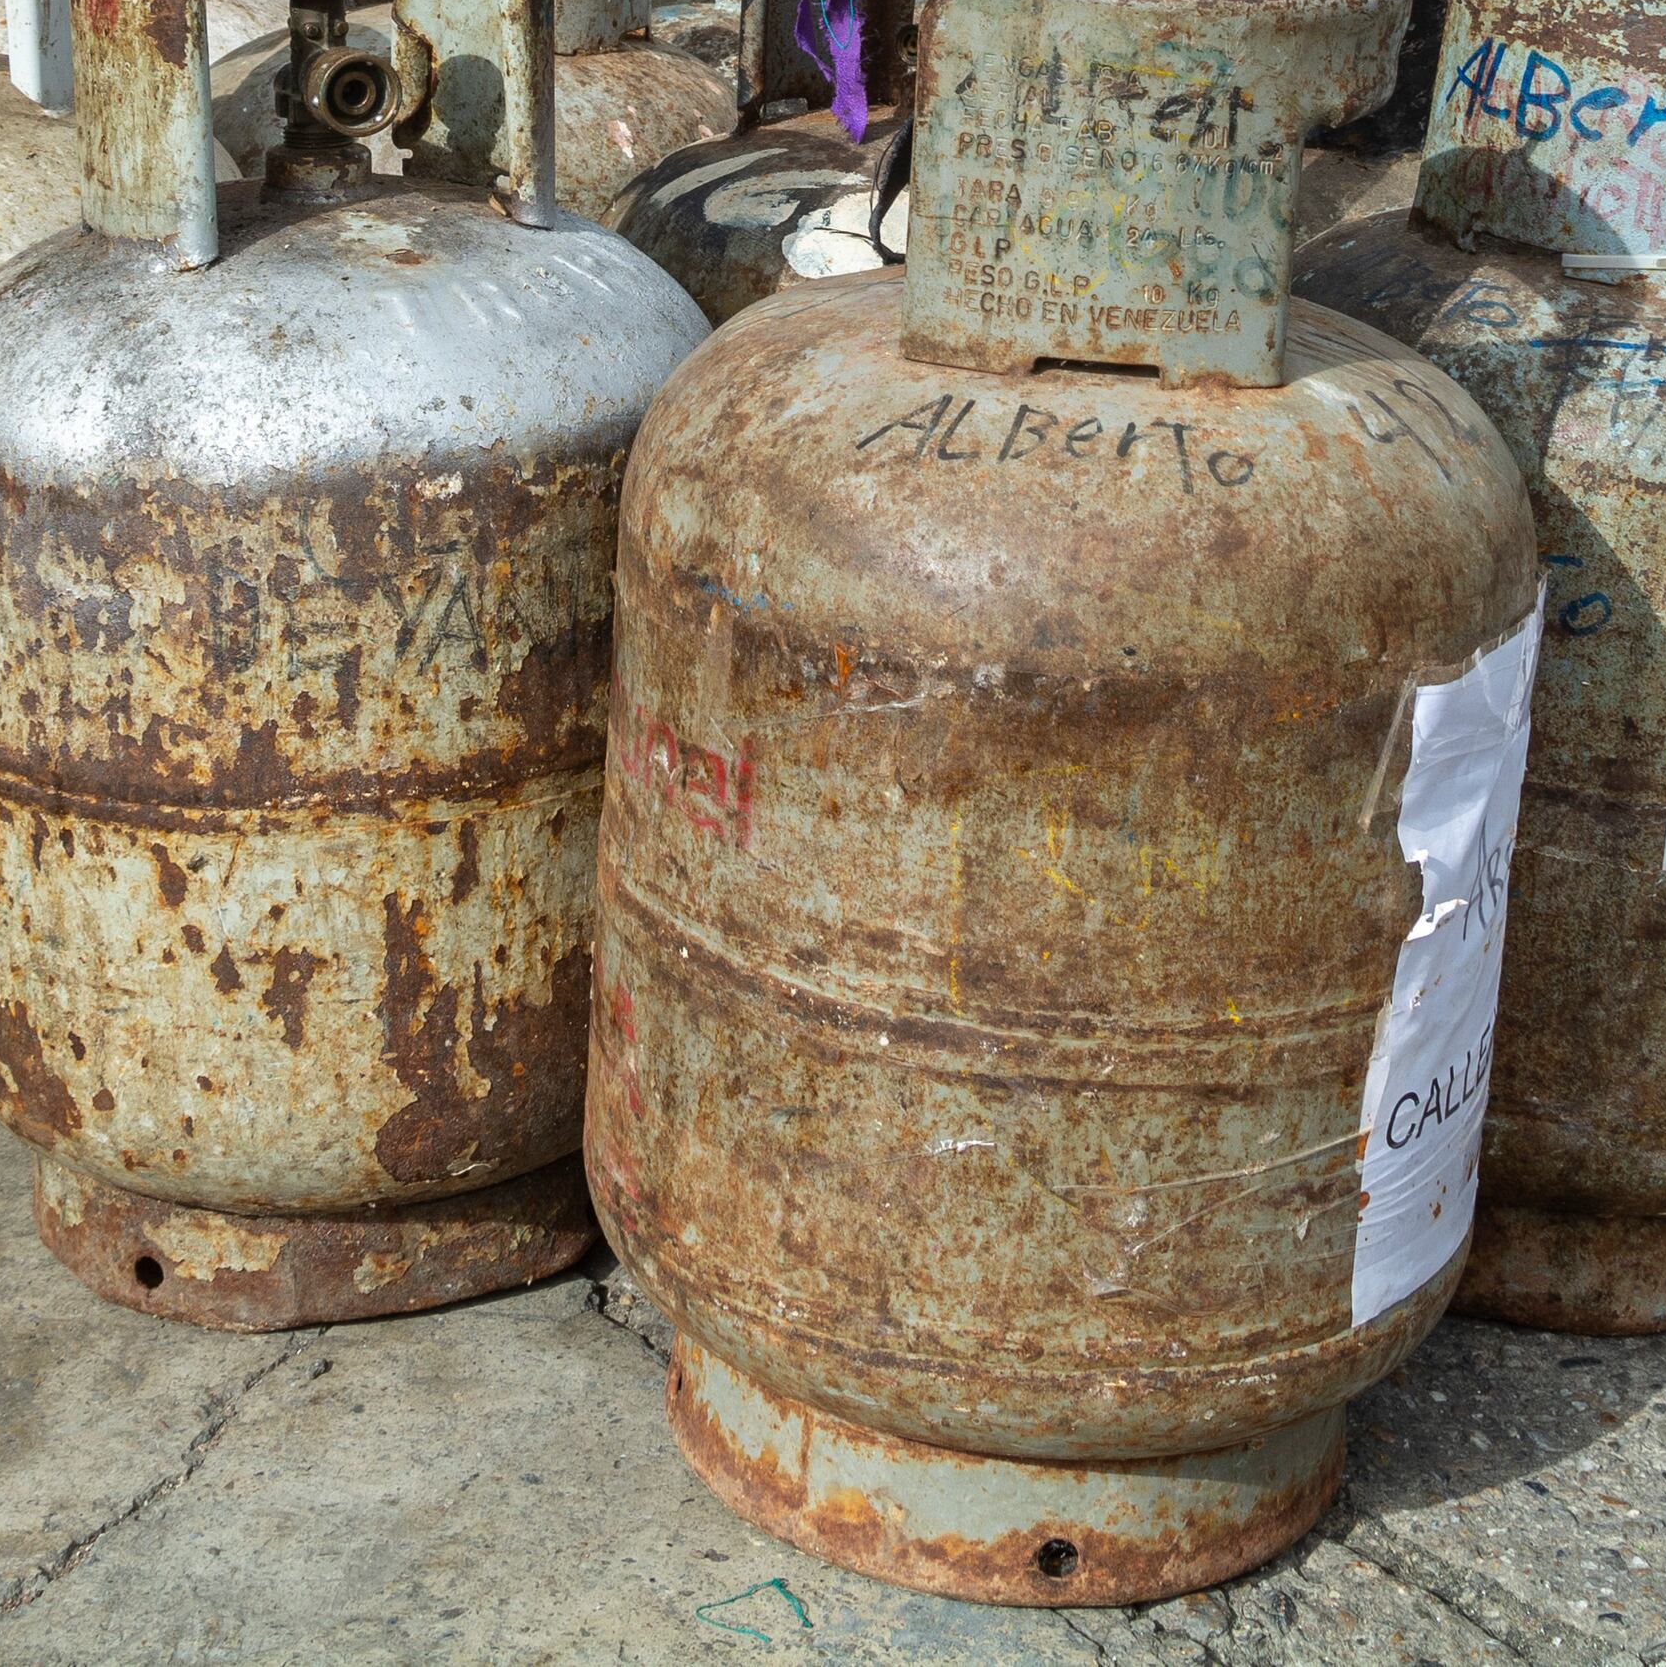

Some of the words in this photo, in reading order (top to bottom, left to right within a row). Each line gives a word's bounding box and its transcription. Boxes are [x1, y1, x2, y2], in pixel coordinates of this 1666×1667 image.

[957, 131, 1026, 160] PRES
[957, 175, 1022, 208] TARA
[1020, 213, 1094, 242] AGUA
[947, 258, 1015, 287] PESO
[944, 285, 1032, 320] HECHO
[1042, 300, 1078, 327] EN
[1089, 305, 1243, 333] VENEZUELA
